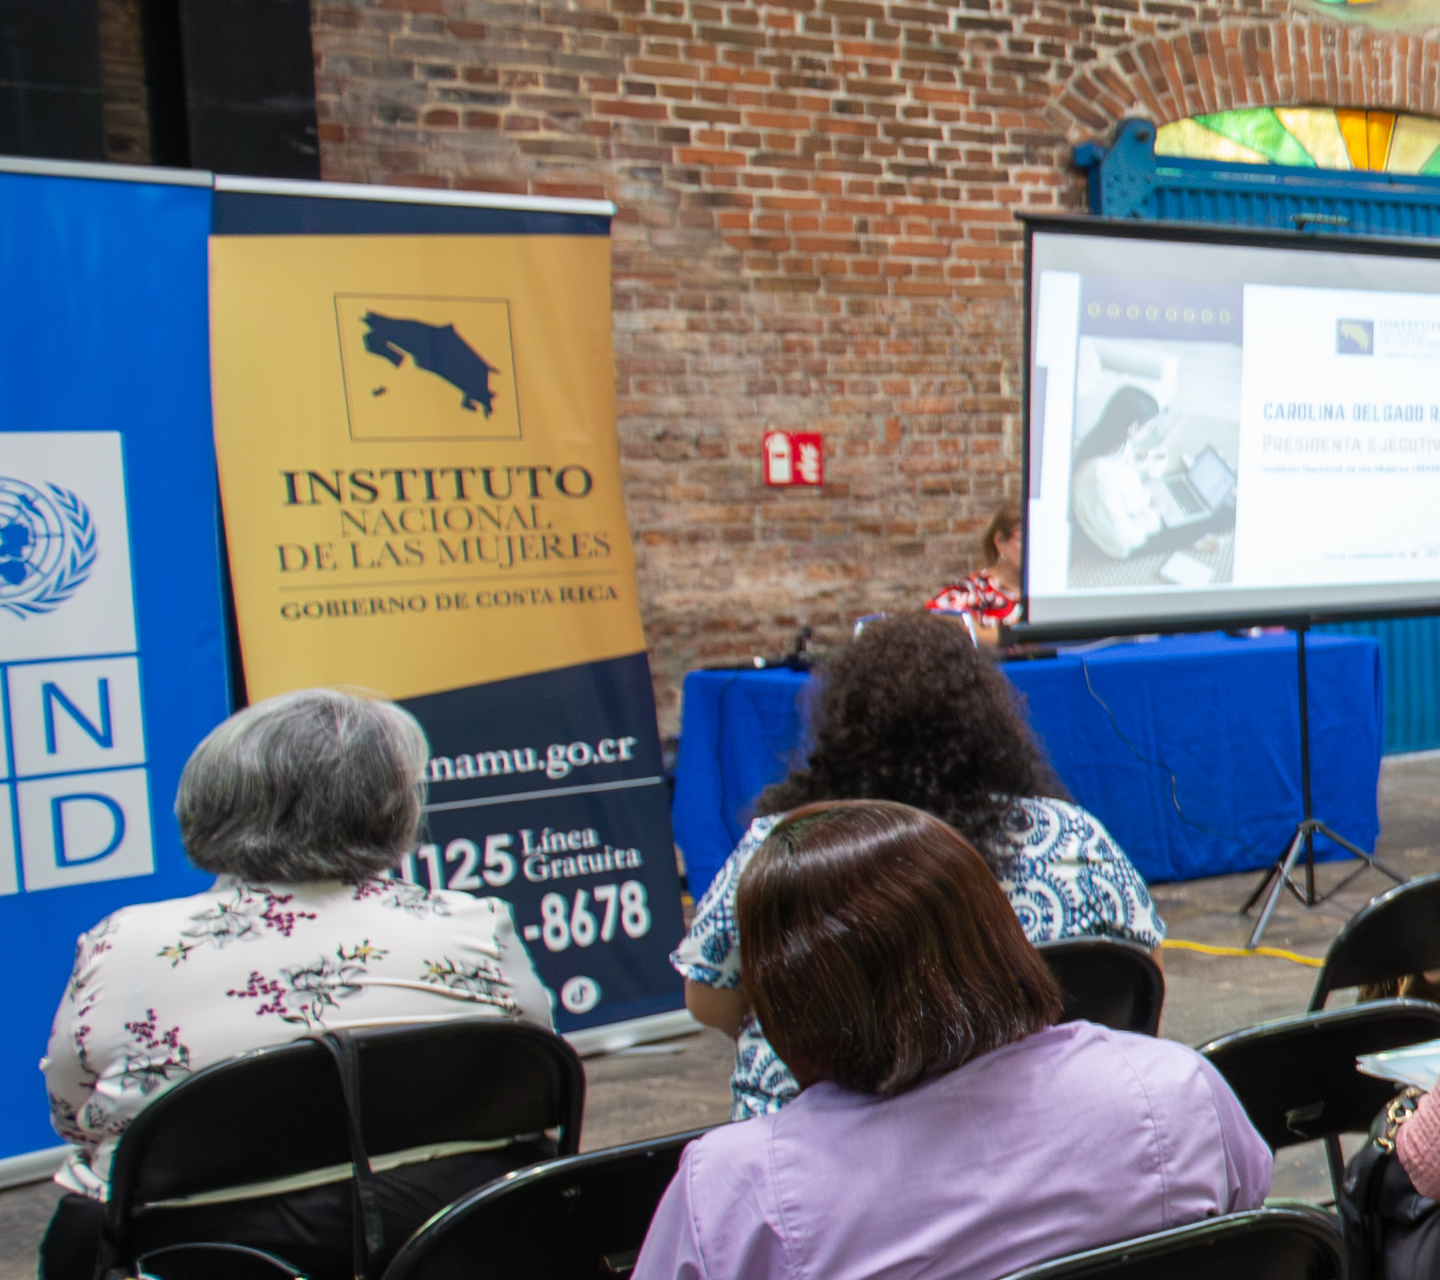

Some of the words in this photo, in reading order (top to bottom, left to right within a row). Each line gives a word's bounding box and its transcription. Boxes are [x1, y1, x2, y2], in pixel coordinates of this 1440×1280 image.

[1263, 402, 1345, 421] CAROLINA
[1352, 403, 1424, 422] DELGADO
[279, 464, 595, 506] INSTITUTO
[339, 504, 553, 537] NACIONAL
[275, 541, 338, 573] DE
[350, 539, 425, 570] LAS
[437, 531, 612, 569] MUJERES
[279, 595, 427, 621] GOBIERNO
[436, 591, 469, 612] DE
[476, 588, 552, 608] COSTA
[559, 584, 619, 604] RICA
[419, 736, 637, 779] namu.go.cr
[520, 827, 601, 858] Línea
[523, 845, 644, 883] Gratuita
